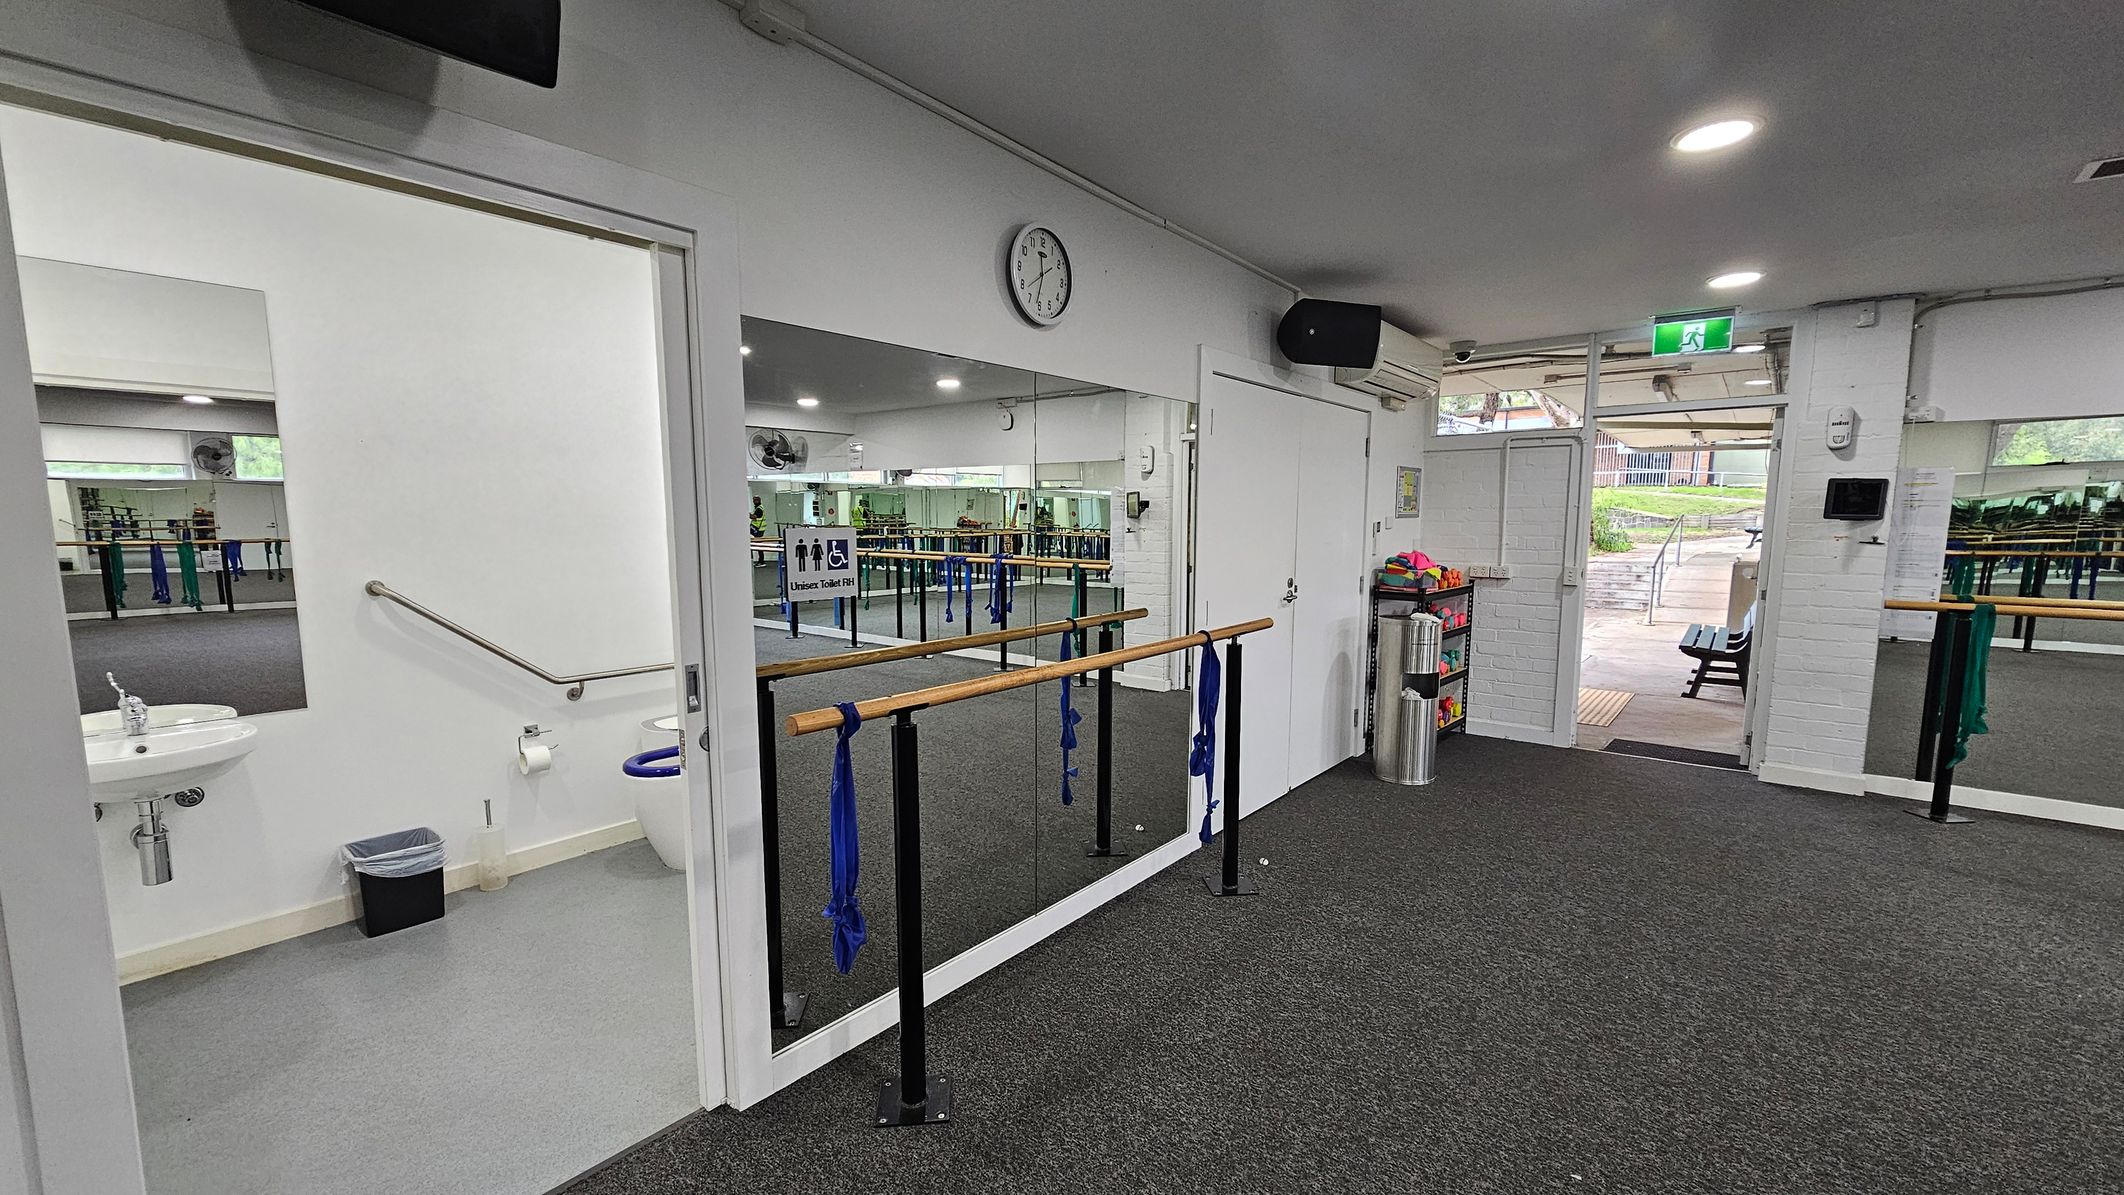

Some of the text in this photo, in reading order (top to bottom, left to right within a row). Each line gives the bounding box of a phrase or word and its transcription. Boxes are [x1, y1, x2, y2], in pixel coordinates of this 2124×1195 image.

[1030, 236, 1035, 248] 11
[1040, 236, 1046, 248] 12
[1022, 244, 1028, 256] 10
[1051, 246, 1054, 256] 1
[1018, 260, 1022, 271] 9
[1057, 260, 1060, 270] 2
[1020, 279, 1024, 290] 8
[1060, 278, 1064, 288] 3
[1028, 292, 1032, 303] 7
[1056, 292, 1060, 302] 4
[1038, 301, 1042, 311] 6
[1048, 300, 1052, 310] 5
[790, 578, 854, 590] Unisex Toilet RH
